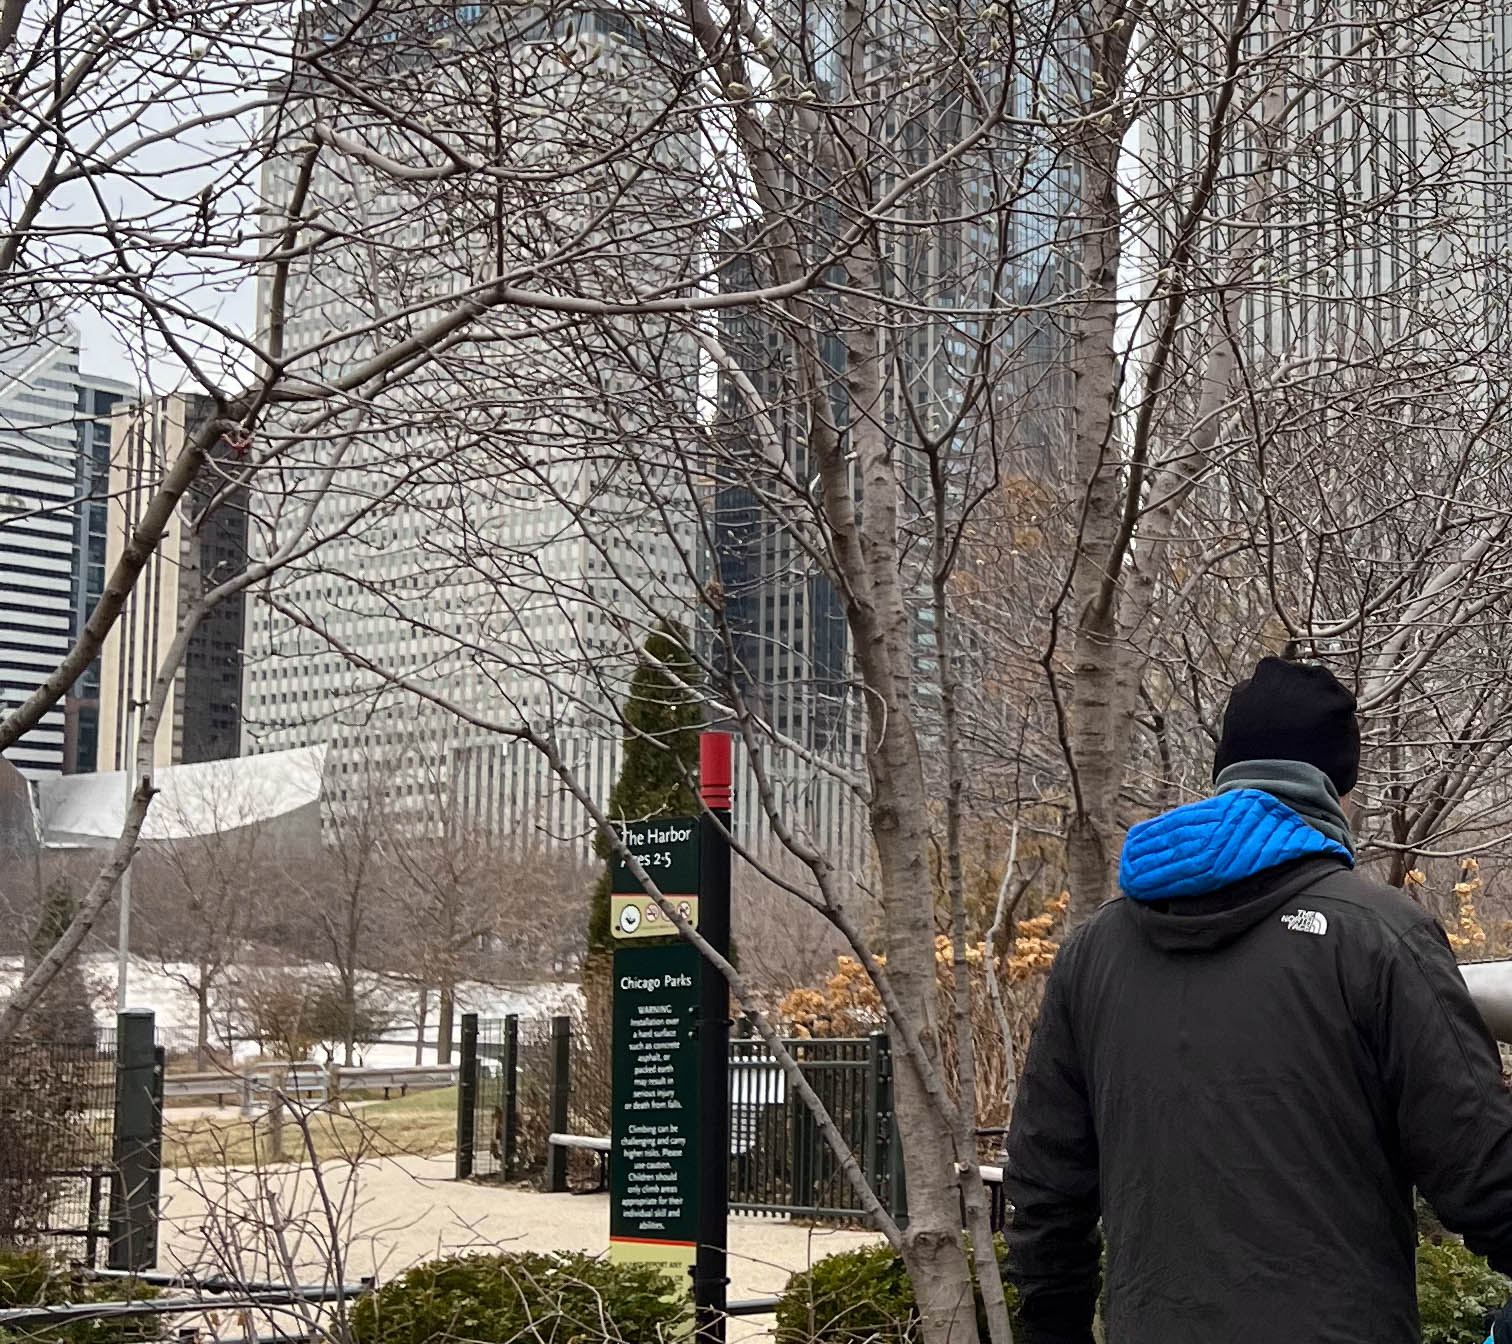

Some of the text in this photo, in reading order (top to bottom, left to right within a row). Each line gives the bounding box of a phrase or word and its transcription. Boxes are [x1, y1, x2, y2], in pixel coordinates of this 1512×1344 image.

[647, 825, 692, 844] Harbor
[620, 851, 672, 869] es 2-5
[620, 974, 692, 992] Chicago Parks
[637, 1004, 673, 1015] WARNING
